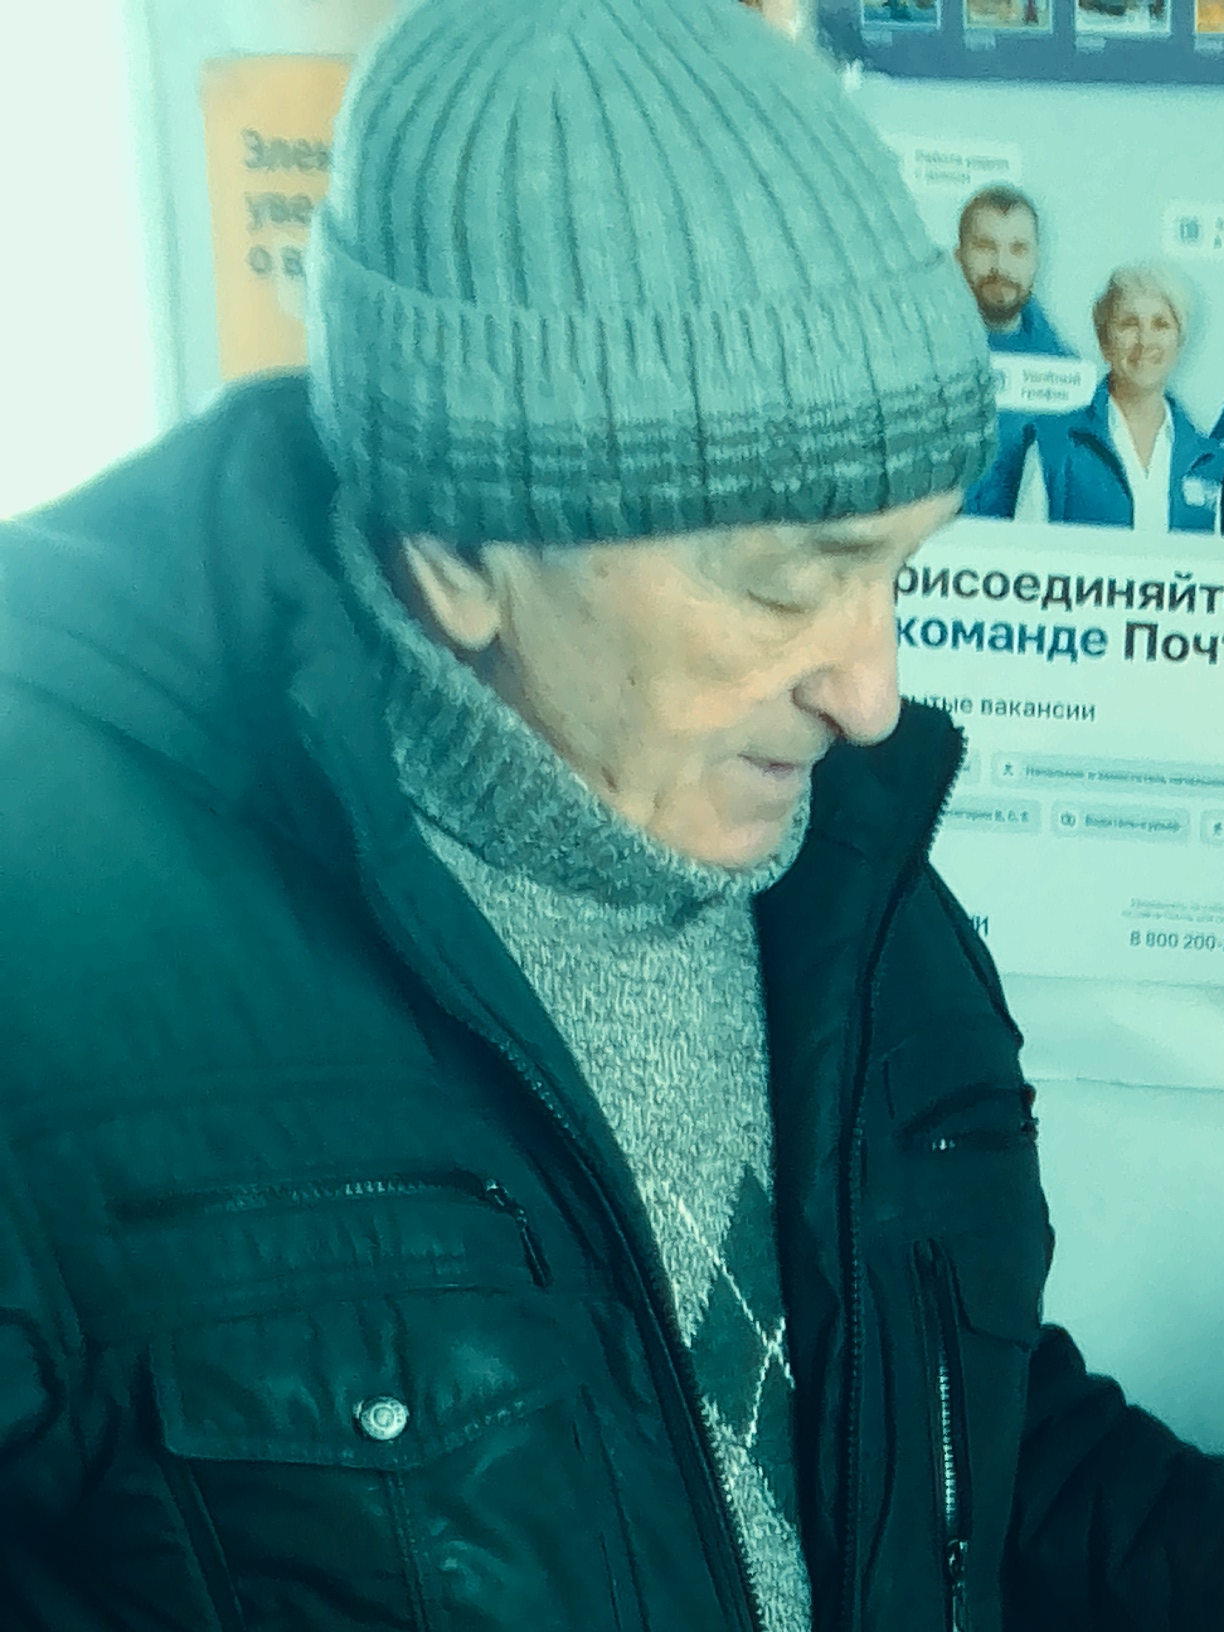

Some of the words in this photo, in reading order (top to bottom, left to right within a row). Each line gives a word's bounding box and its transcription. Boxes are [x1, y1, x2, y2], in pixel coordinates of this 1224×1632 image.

[895, 616, 1109, 664] команде
[980, 698, 1096, 723] вакансии
[1146, 931, 1179, 949] 800
